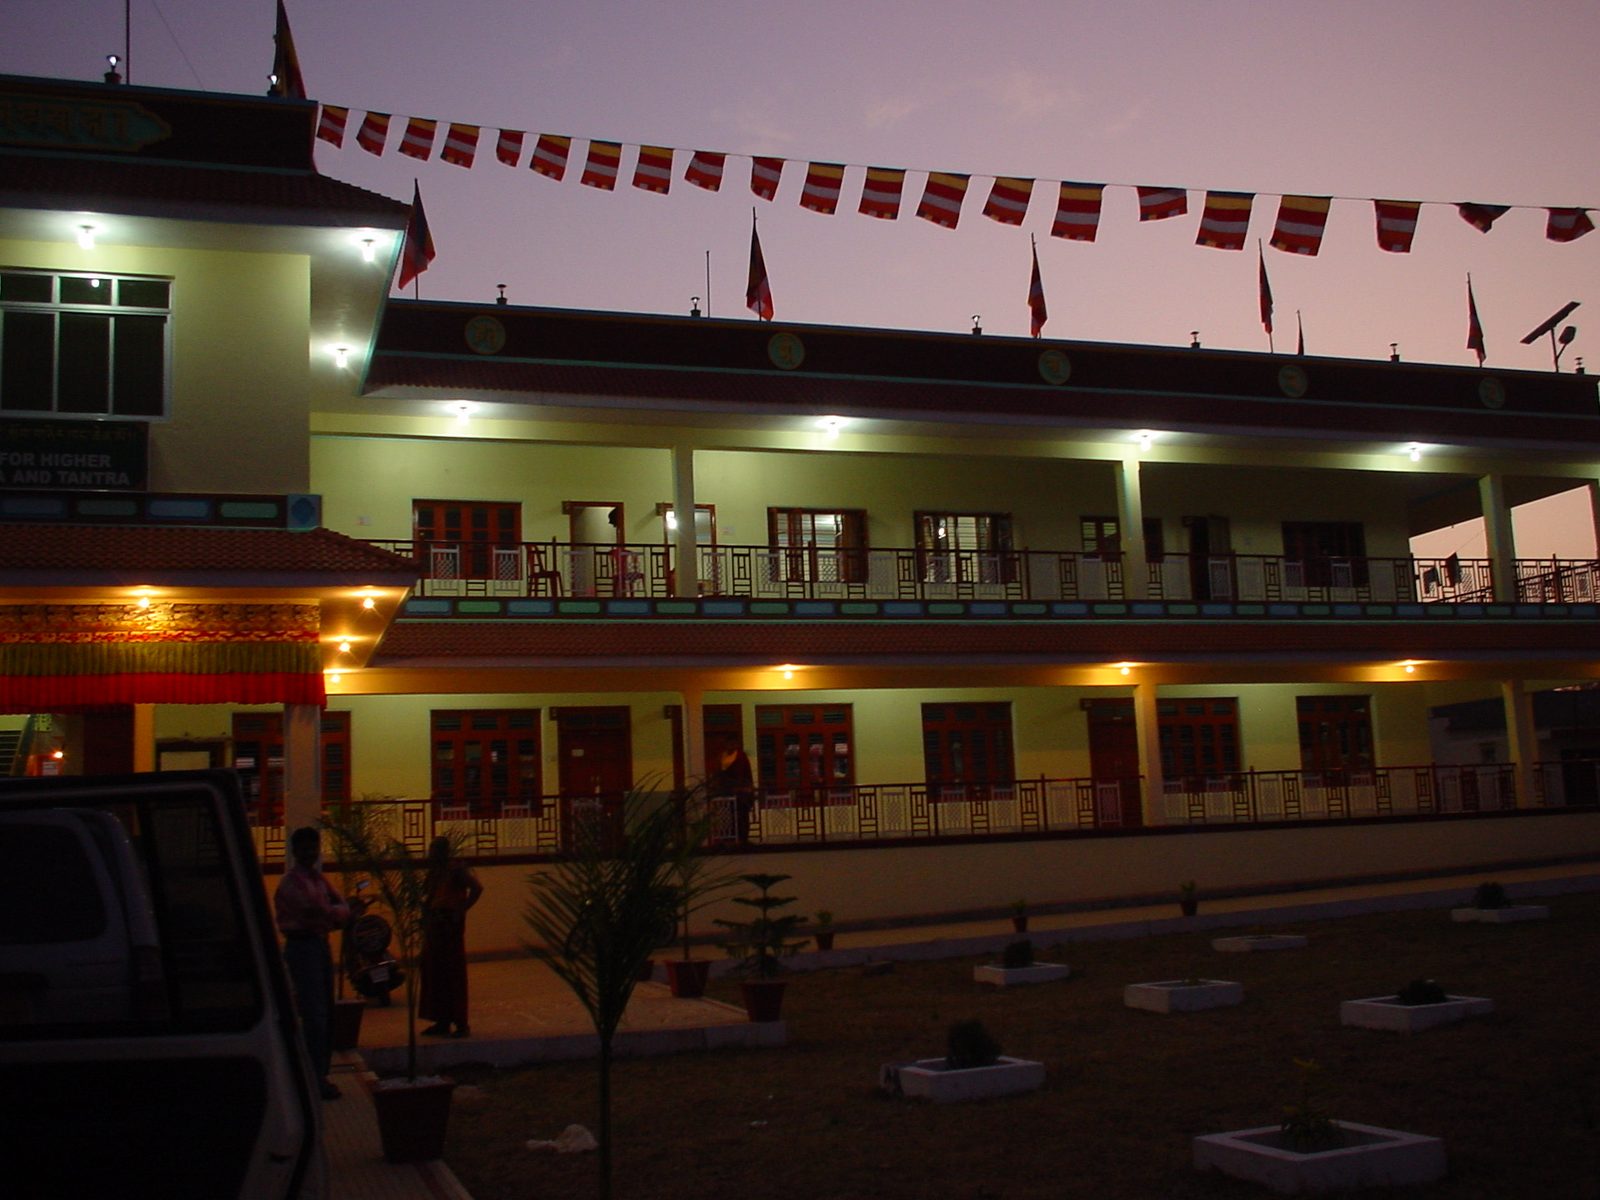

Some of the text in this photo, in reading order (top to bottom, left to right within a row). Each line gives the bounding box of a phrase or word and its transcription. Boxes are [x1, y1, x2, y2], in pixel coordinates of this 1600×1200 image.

[0, 452, 112, 468] FOR HIGHER
[14, 469, 51, 484] AND
[56, 470, 131, 486] TANTRA
